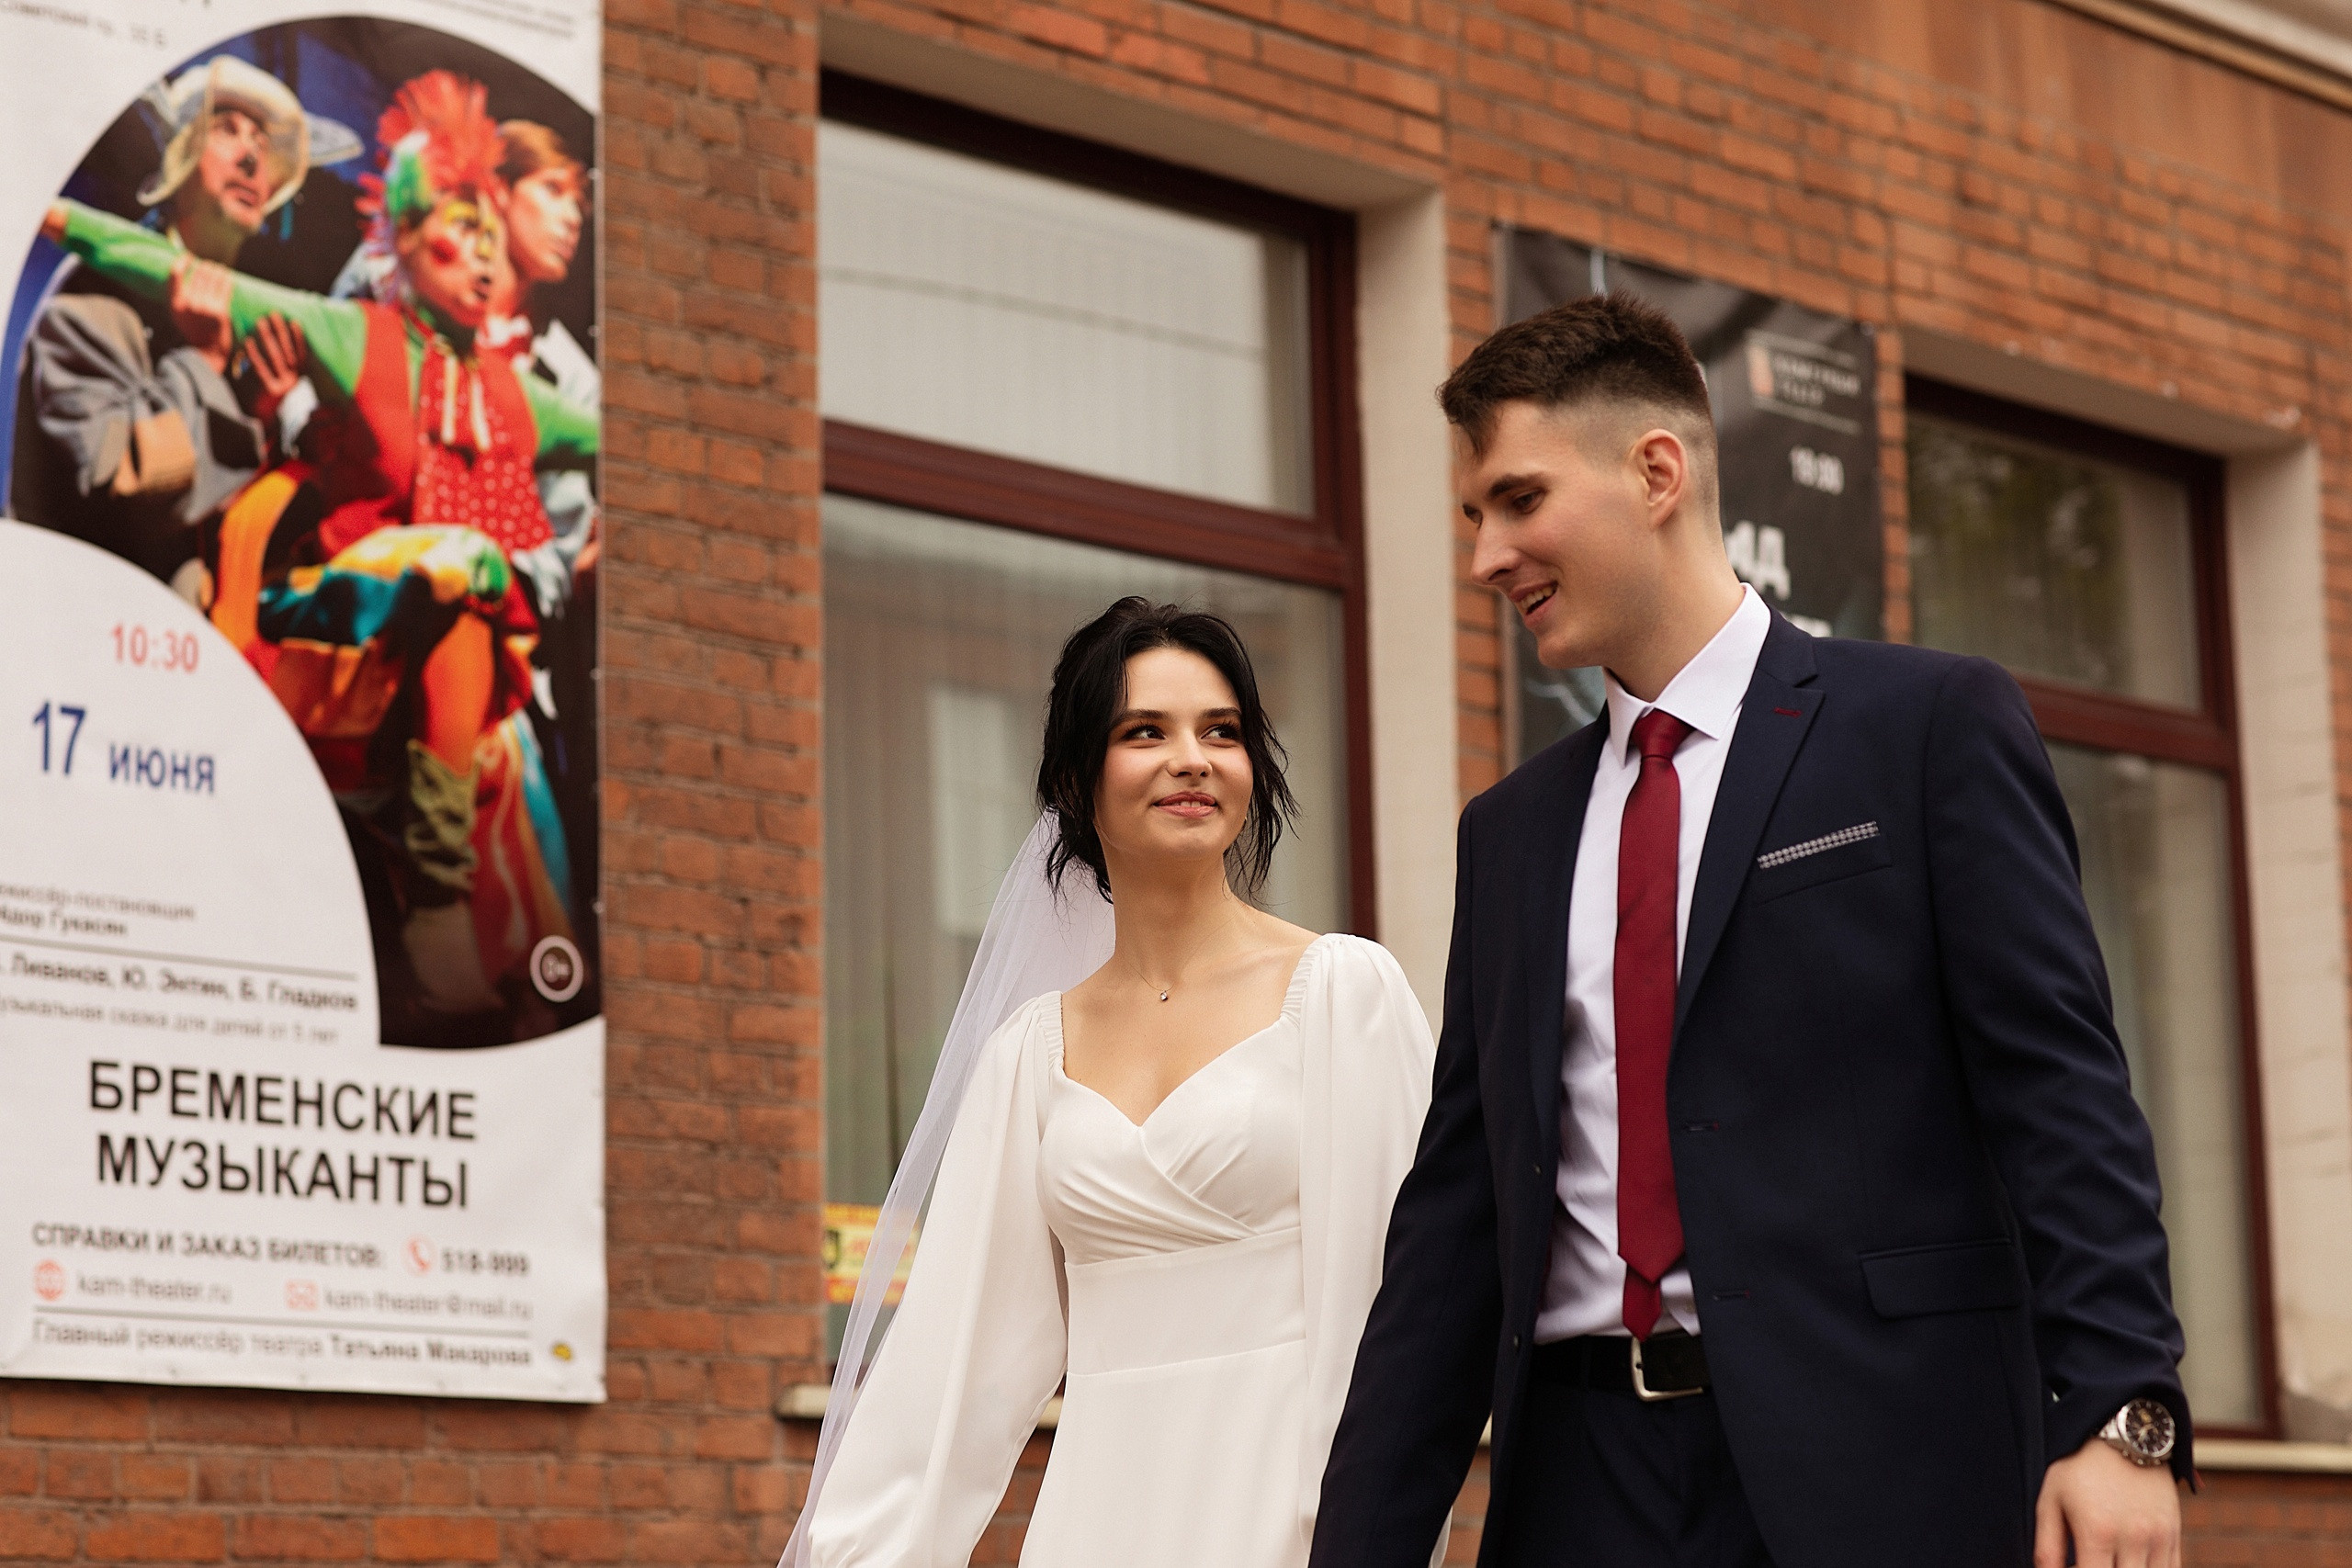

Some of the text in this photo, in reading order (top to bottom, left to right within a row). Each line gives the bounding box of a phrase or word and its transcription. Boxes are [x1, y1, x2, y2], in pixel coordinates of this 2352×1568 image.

[111, 622, 200, 673] 10:30
[32, 700, 86, 774] 17
[11, 952, 116, 988] Ливанов,
[267, 981, 359, 1013] Гладков
[110, 1005, 168, 1030] сказка
[89, 1060, 478, 1141] БРЕМЕНСКИЕ
[96, 1133, 469, 1208] МУЗЫКАНТЫ
[32, 1222, 149, 1254] СПРАВКИ
[155, 1230, 175, 1256] И
[182, 1231, 261, 1261] ЗАКАЗ
[78, 1274, 231, 1305] kam-theater.ru
[33, 1315, 130, 1347] Главный
[251, 1335, 323, 1357] театра
[330, 1333, 420, 1360] Татьяна
[426, 1339, 531, 1366] Макарова
